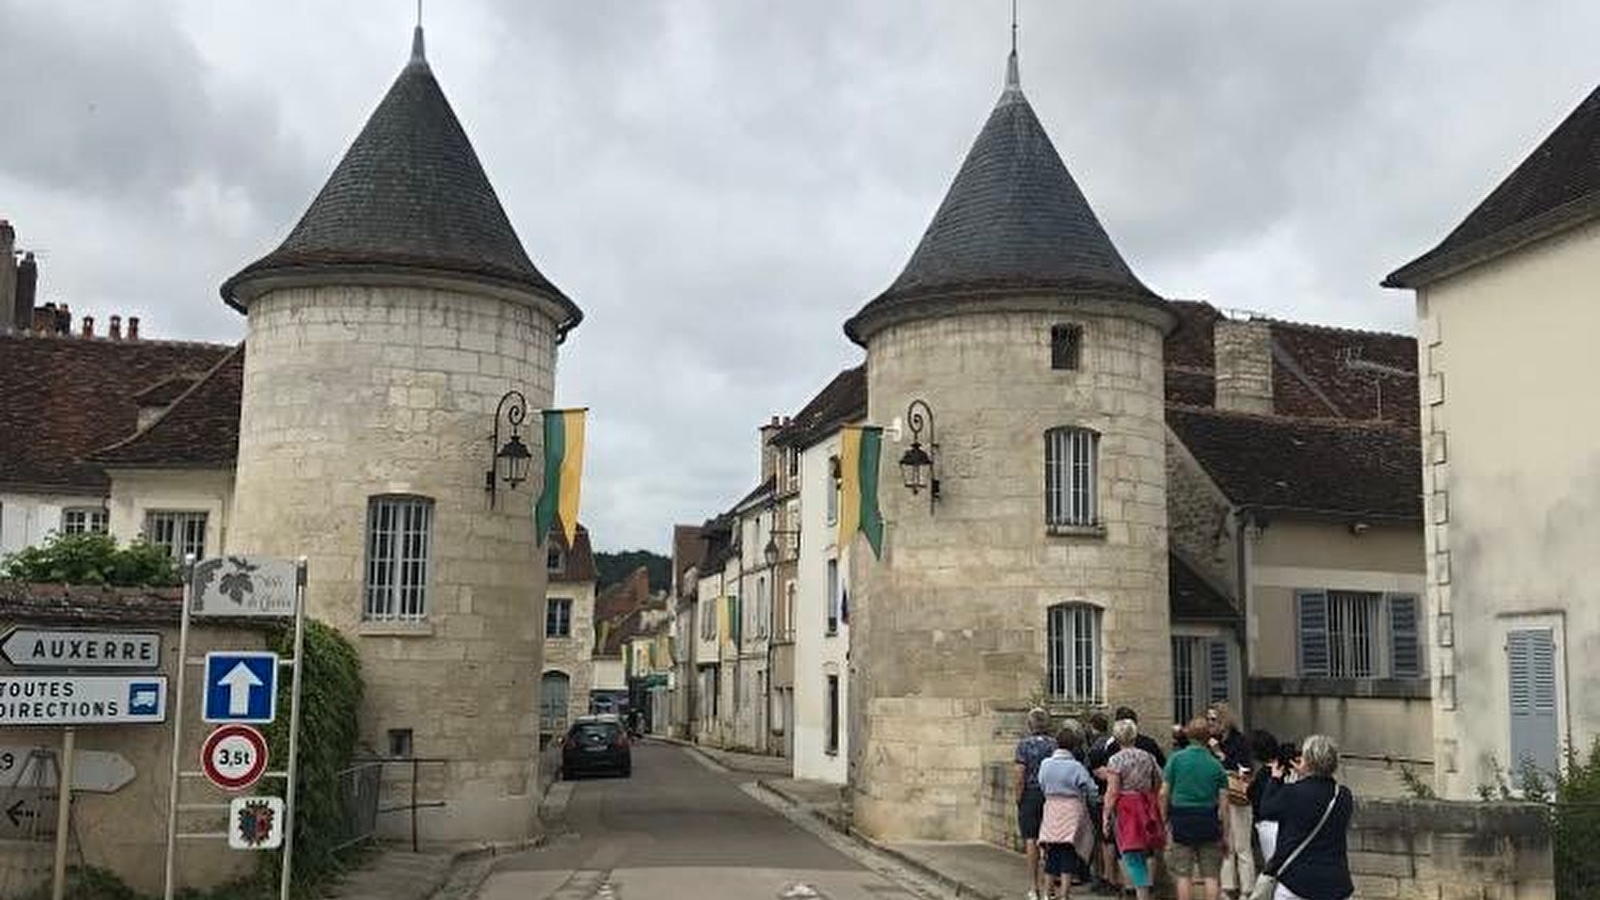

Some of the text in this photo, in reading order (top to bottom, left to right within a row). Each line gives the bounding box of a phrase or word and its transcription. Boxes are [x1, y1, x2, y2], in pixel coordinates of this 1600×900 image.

[32, 639, 152, 660] AUXERRE
[0, 682, 74, 697] TOUTES
[219, 749, 250, 767] 3,5t
